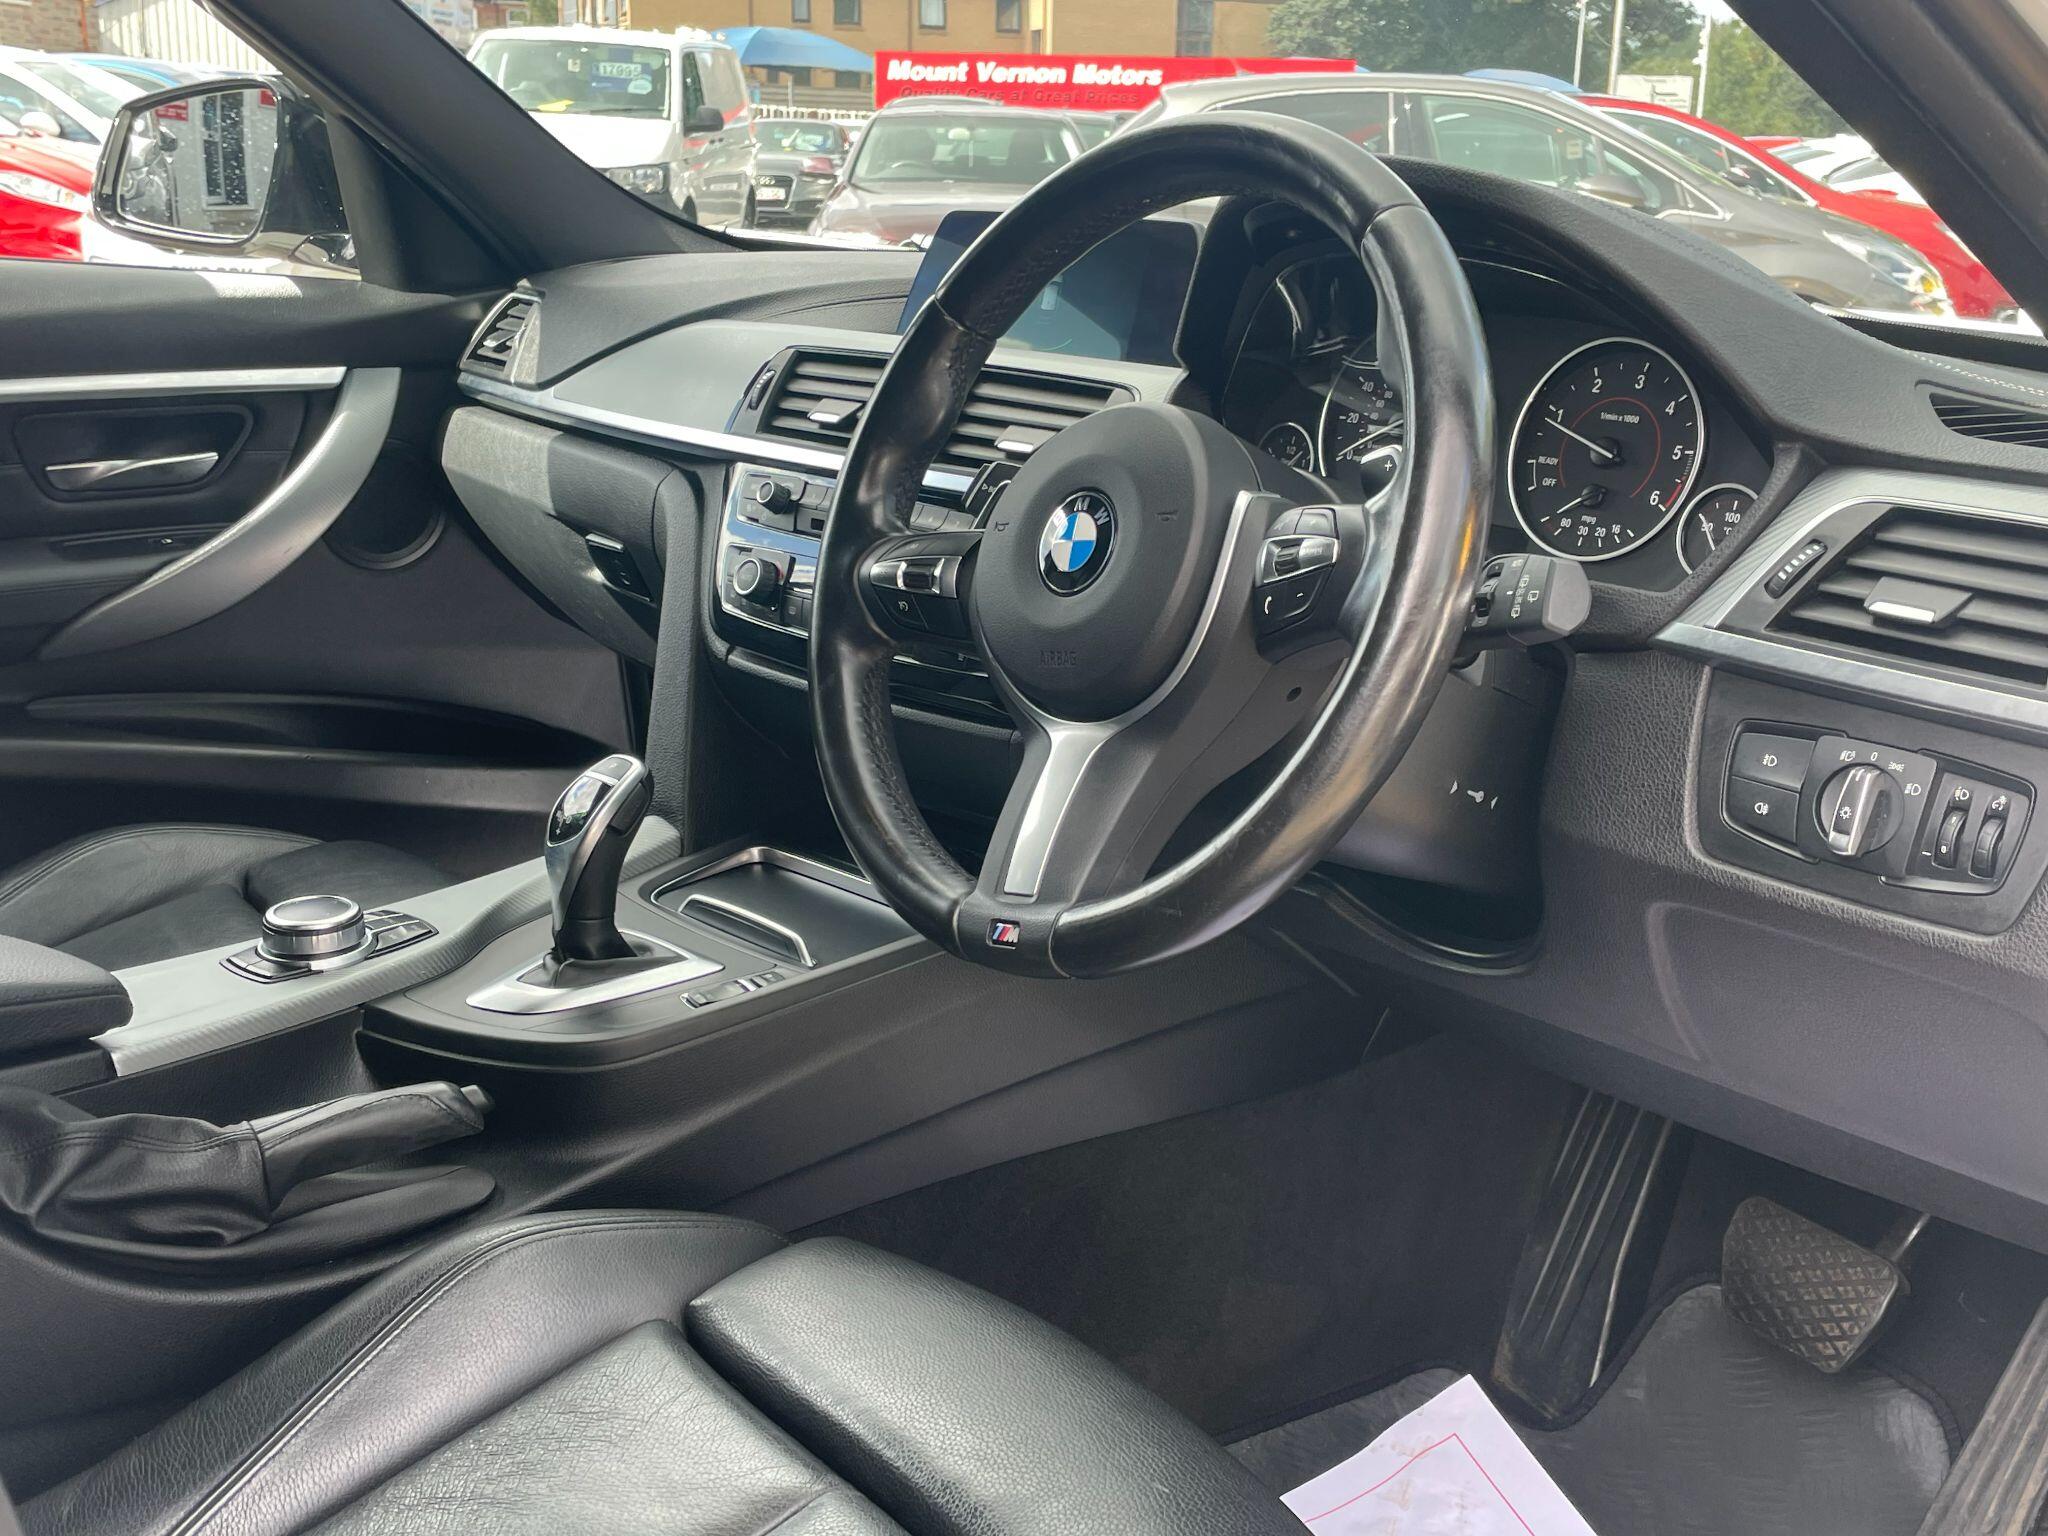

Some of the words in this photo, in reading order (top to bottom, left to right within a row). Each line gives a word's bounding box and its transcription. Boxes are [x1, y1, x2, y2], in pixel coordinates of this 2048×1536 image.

[887, 60, 969, 82] Mount
[976, 62, 1066, 84] Vernon
[1072, 64, 1163, 85] Motors
[1362, 382, 1373, 392] 40
[1592, 378, 1602, 393] 2
[1635, 375, 1645, 389] 3
[1665, 401, 1675, 416] 4
[1347, 412, 1359, 424] 20
[1556, 408, 1564, 423] 1
[1623, 414, 1640, 424] 1000
[1672, 445, 1683, 460] 5
[1538, 456, 1559, 466] READY
[1542, 478, 1556, 487] OFF
[1650, 490, 1660, 506] 6
[1053, 497, 1110, 527] BMW
[1724, 512, 1741, 524] 100
[1560, 518, 1571, 528] 80
[1581, 515, 1596, 524] mpg
[1578, 526, 1588, 535] 30
[1595, 527, 1605, 537] 20
[1611, 524, 1621, 534] 16
[1039, 650, 1077, 666] AIRBAG
[1871, 752, 1878, 761] 0
